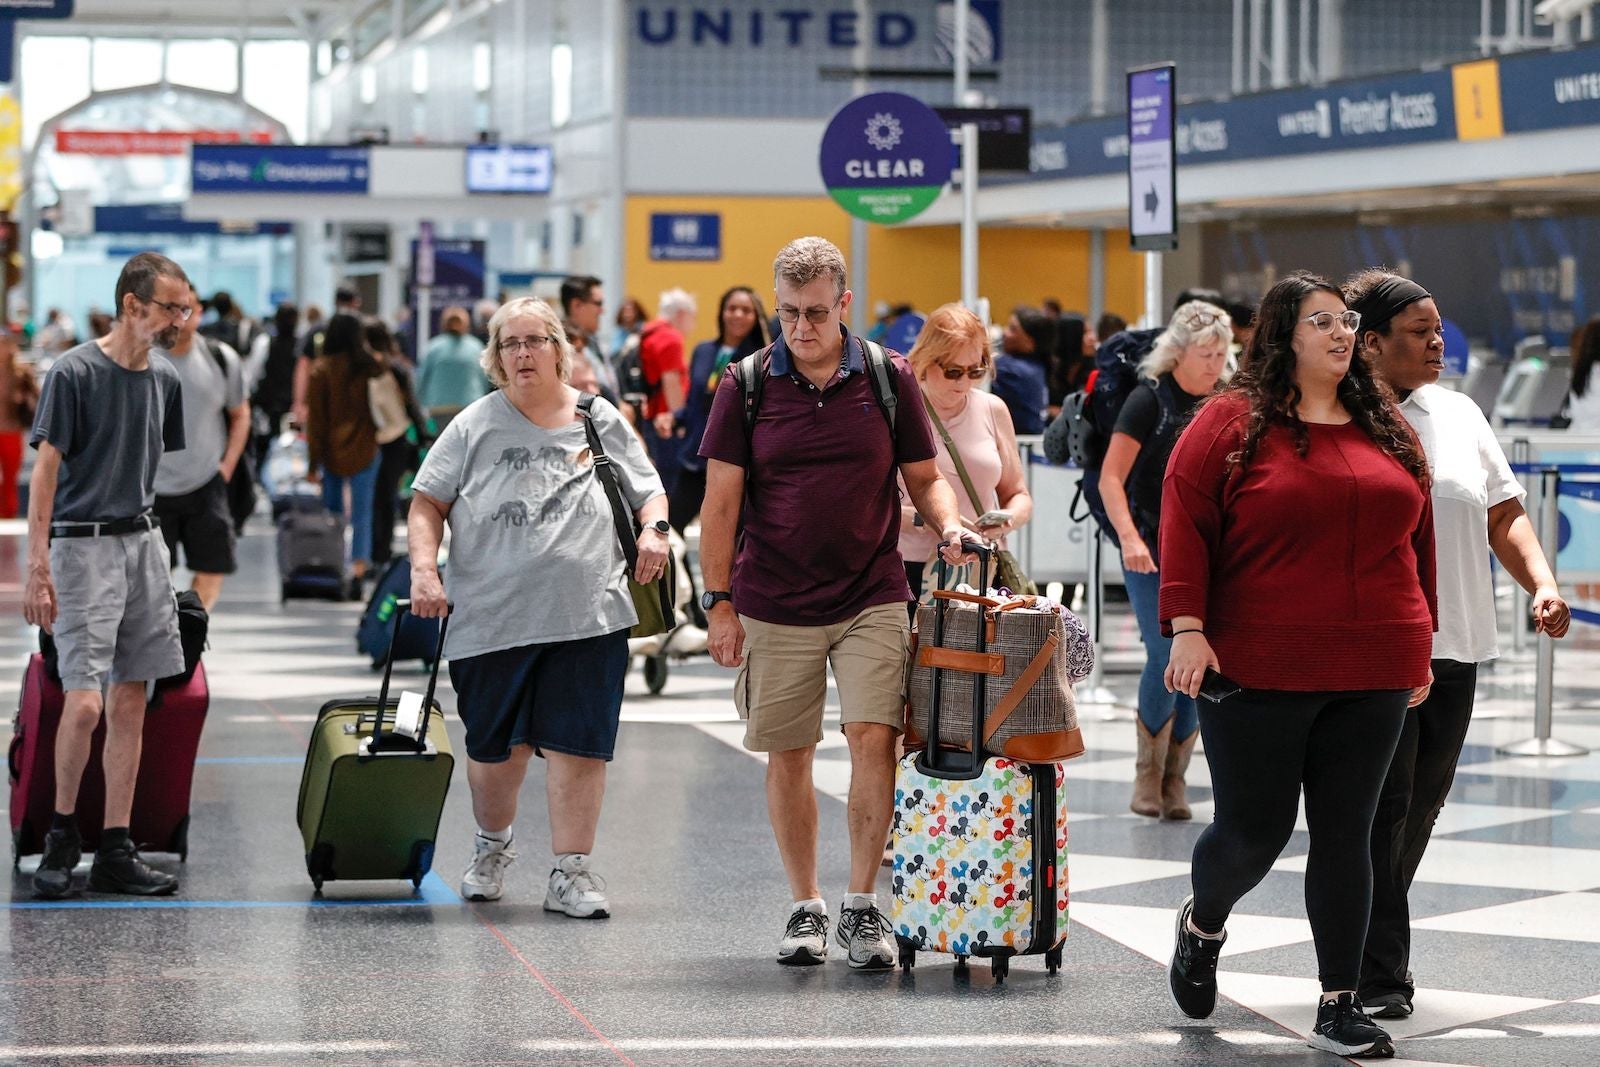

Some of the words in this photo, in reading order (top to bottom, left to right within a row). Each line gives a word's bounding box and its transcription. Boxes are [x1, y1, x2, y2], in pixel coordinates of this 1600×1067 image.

[637, 9, 916, 48] UNITED
[1554, 72, 1600, 103] UNITE
[1338, 95, 1389, 135] Premier
[1390, 91, 1437, 130] Access
[844, 158, 925, 179] CLEAR
